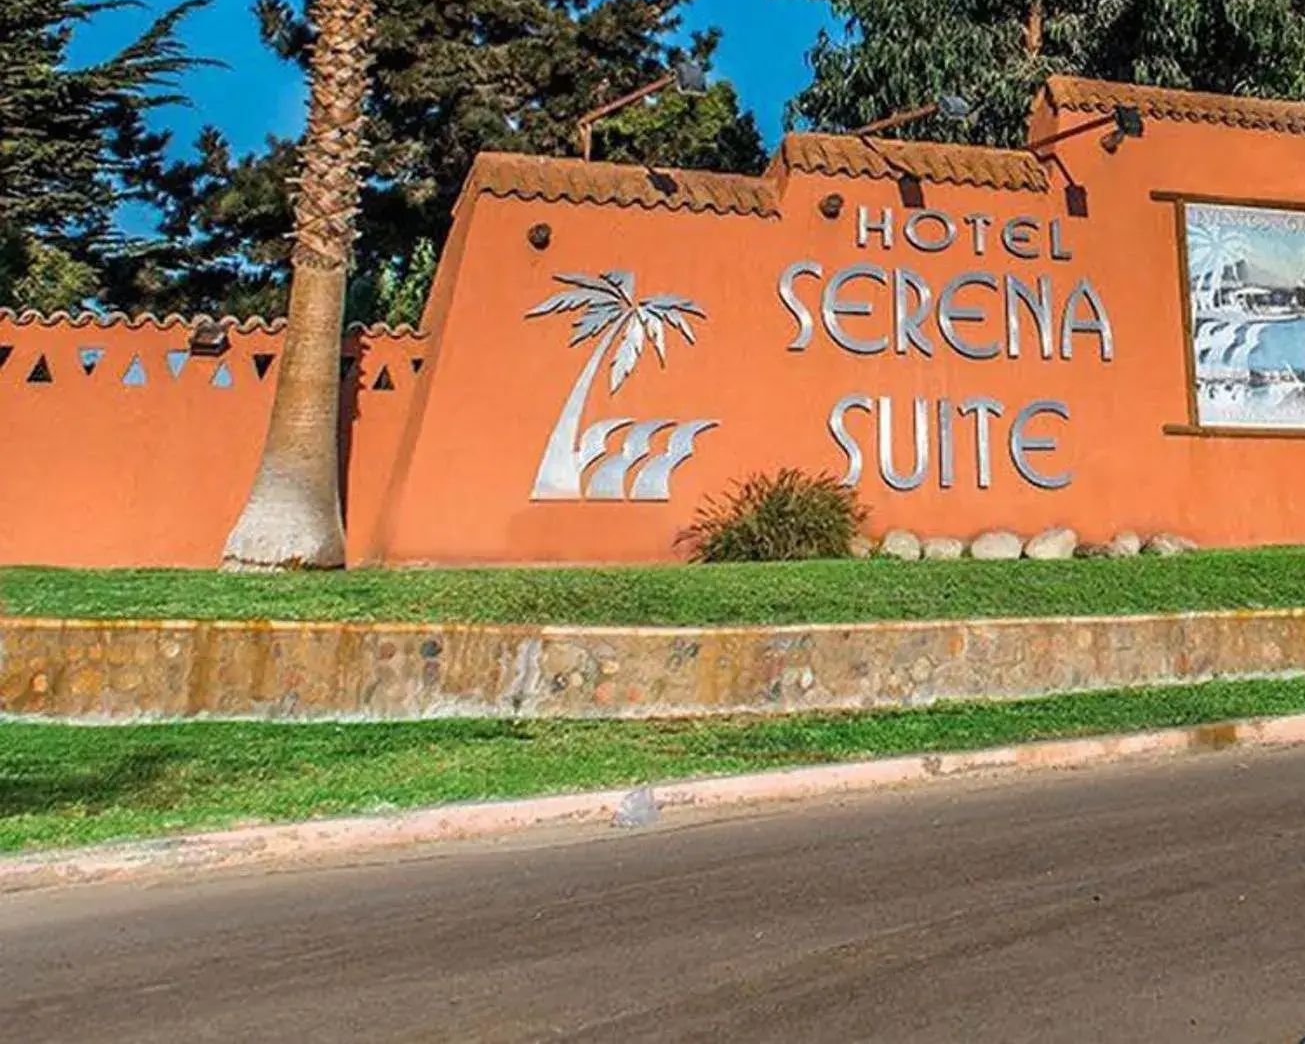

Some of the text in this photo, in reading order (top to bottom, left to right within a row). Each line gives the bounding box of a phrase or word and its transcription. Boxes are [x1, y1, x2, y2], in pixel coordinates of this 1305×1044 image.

[856, 204, 1072, 260] HOTEL
[777, 260, 1114, 362] SERENA
[827, 392, 1073, 491] SUITE
